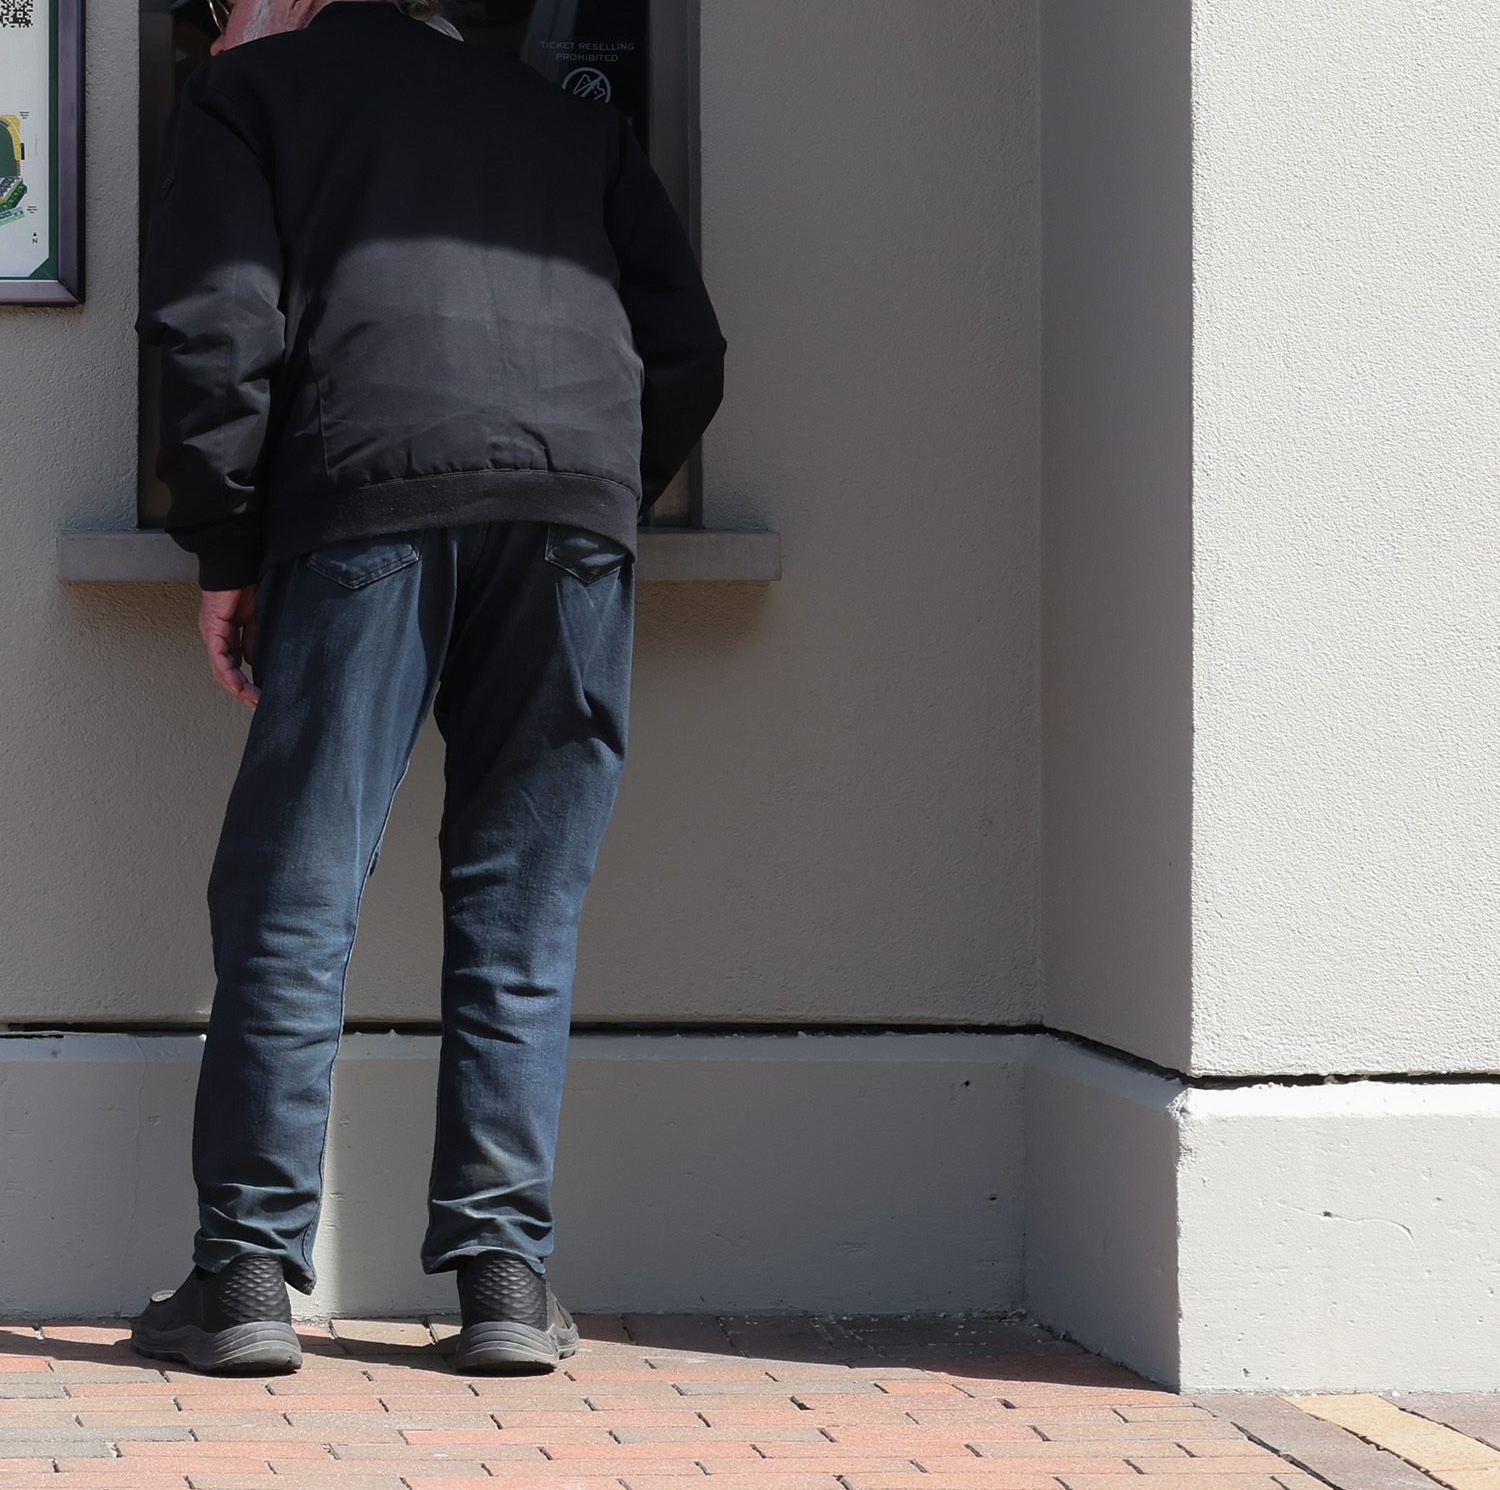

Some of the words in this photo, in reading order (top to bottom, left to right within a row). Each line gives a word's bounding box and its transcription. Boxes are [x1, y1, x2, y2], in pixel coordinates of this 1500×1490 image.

[539, 40, 575, 51] TICKET
[578, 41, 635, 52] RESELLING
[555, 52, 619, 62] PROHIBITED
